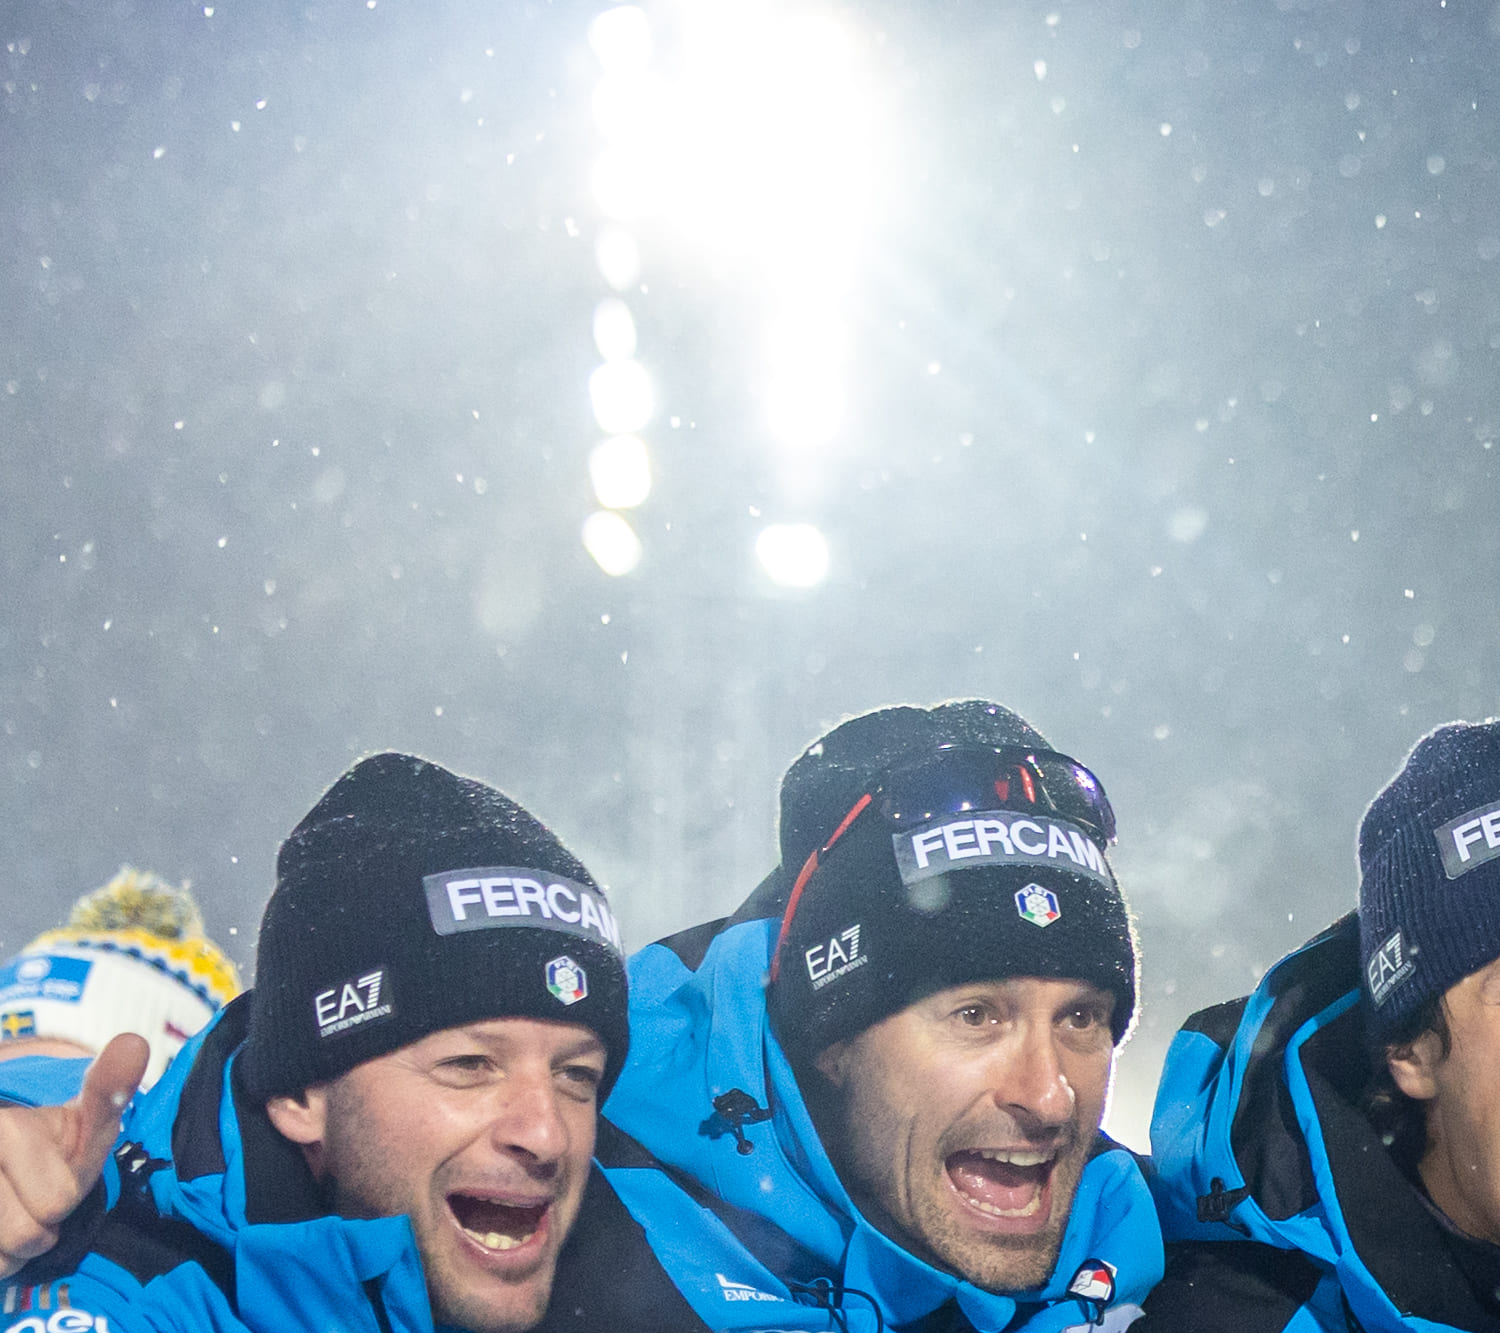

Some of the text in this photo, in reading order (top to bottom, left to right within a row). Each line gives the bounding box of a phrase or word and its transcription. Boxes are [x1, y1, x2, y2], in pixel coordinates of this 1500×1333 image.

[912, 815, 1109, 873] FERCAM
[805, 923, 862, 982] EA7
[315, 971, 382, 1026] EA7
